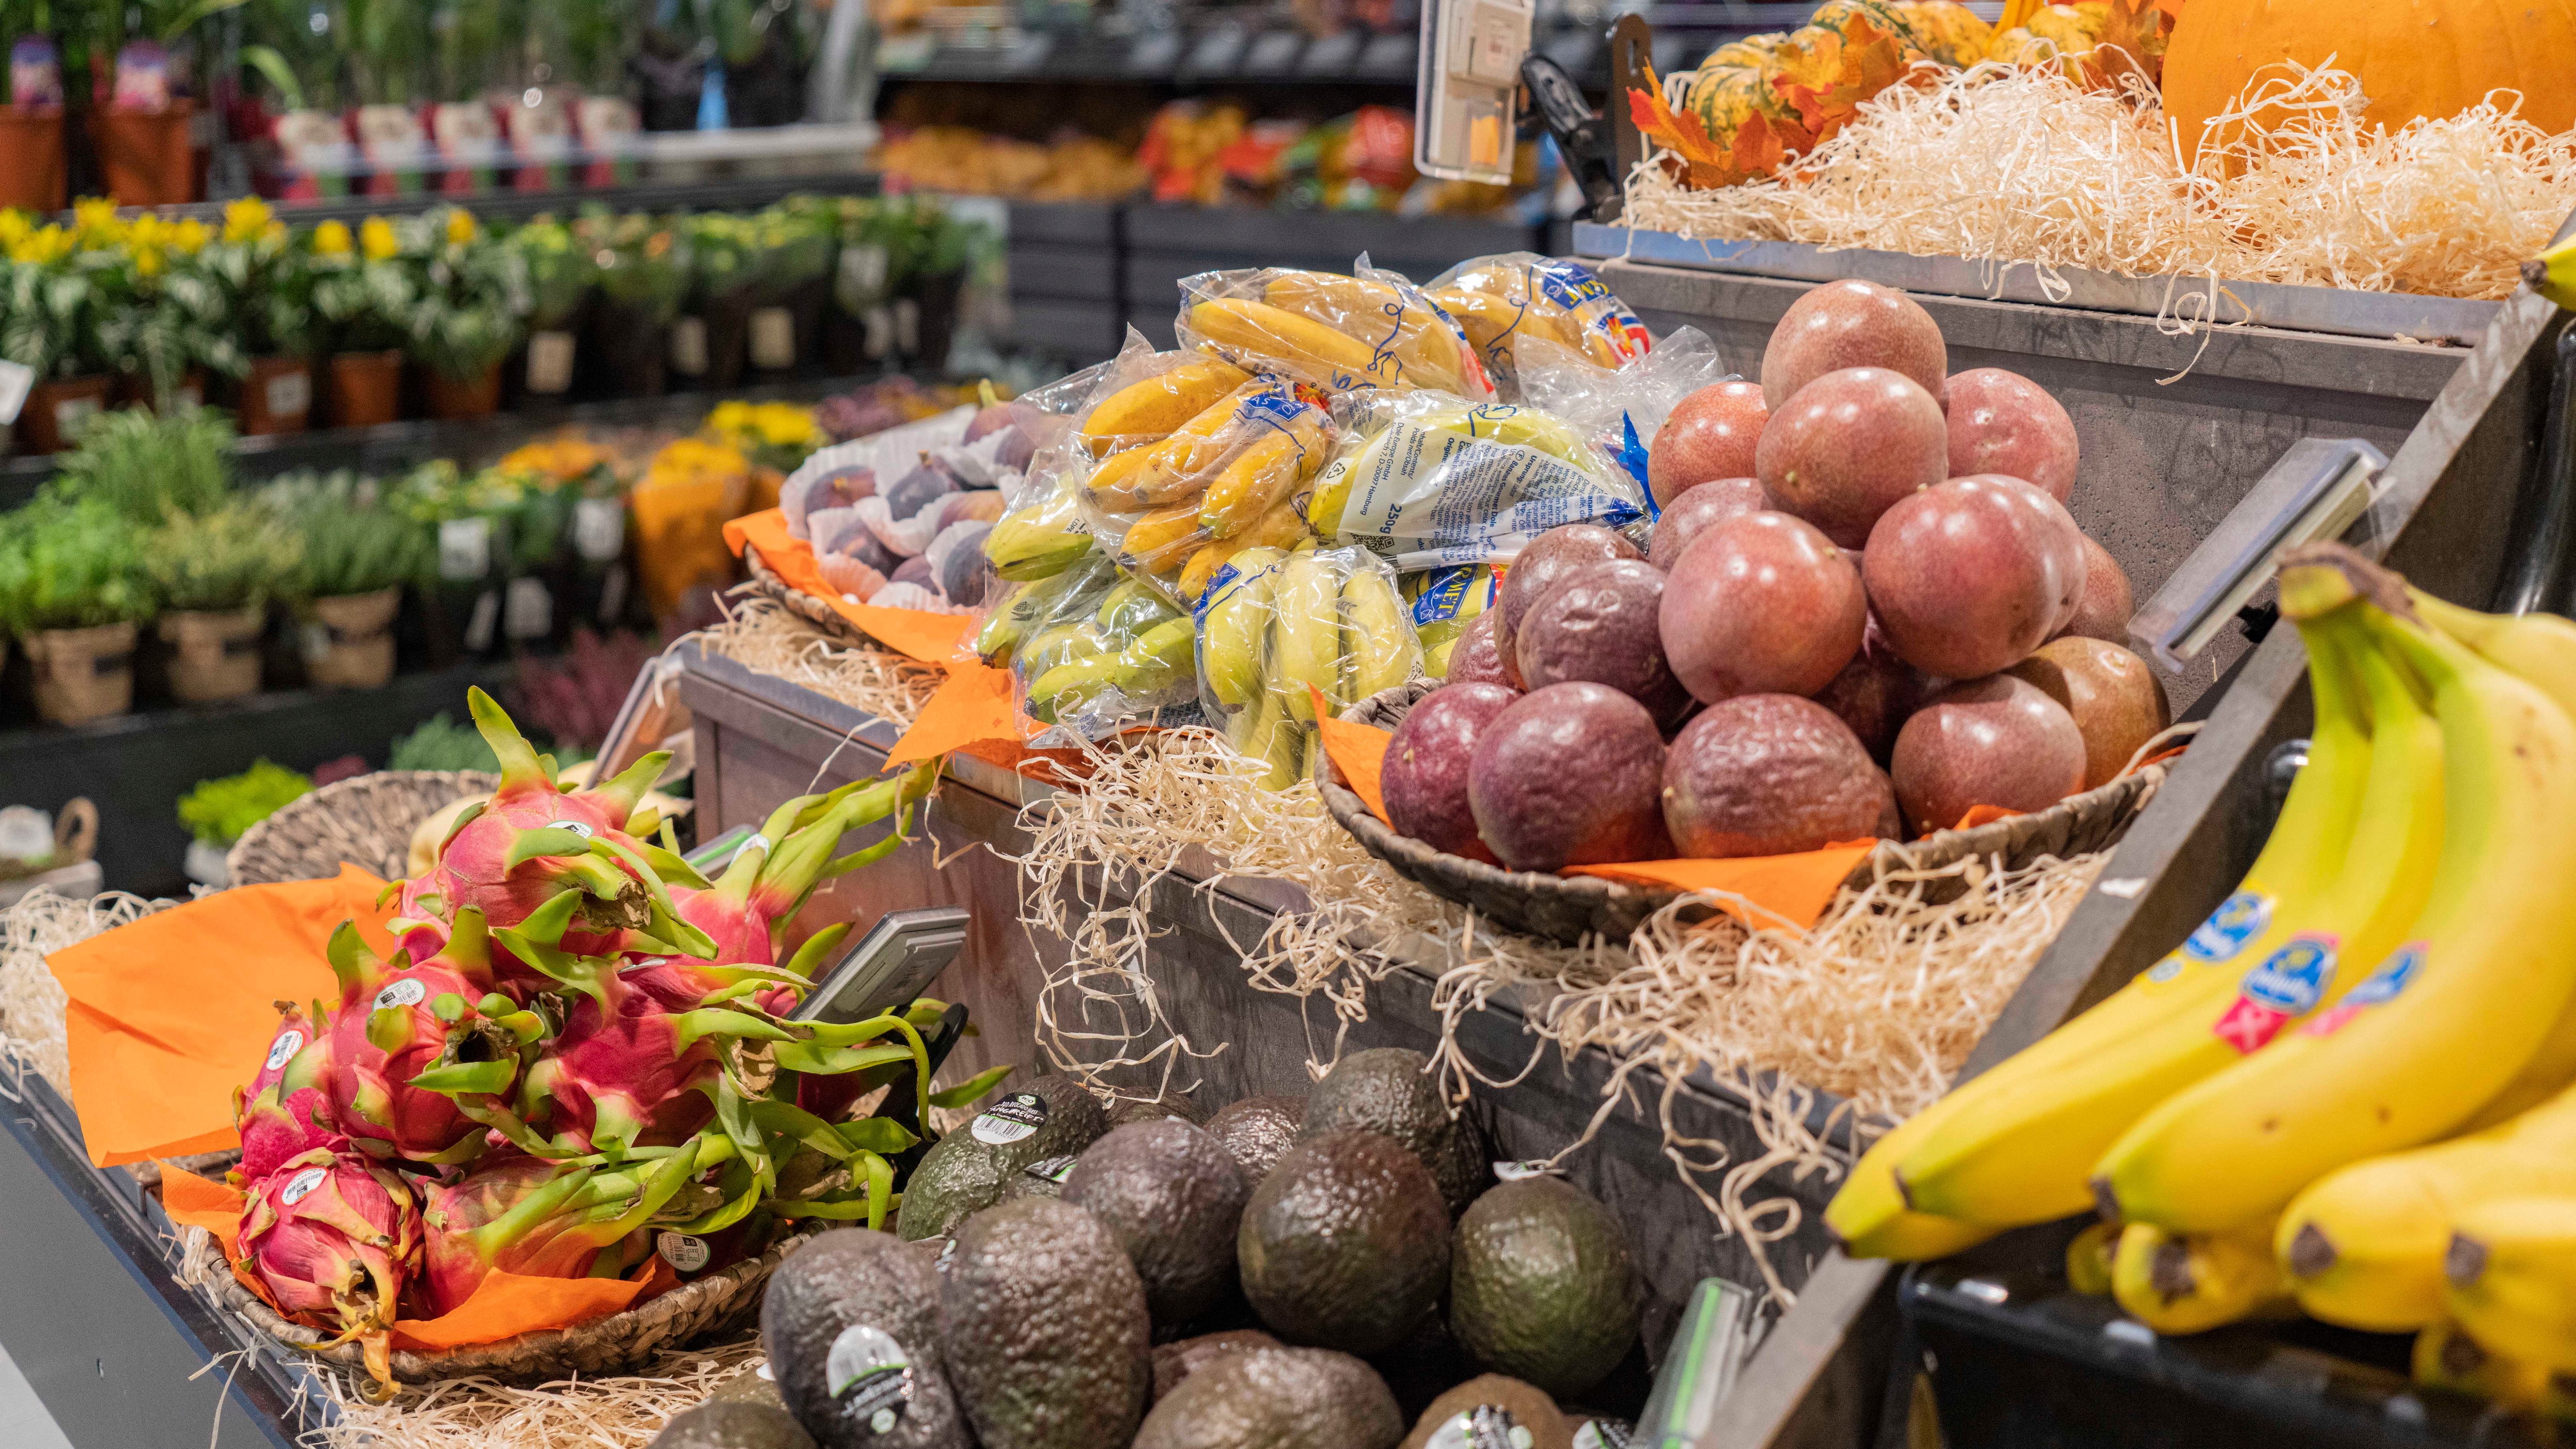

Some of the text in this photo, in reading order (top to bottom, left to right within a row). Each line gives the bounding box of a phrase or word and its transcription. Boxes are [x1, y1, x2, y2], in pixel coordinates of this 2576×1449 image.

[1381, 421, 1404, 481] Dole Europe GmbH
[1400, 427, 1420, 476] Poids net/Obsah
[1439, 436, 1455, 464] Origine:
[1452, 440, 1466, 465] Conseil:
[1462, 442, 1471, 456] pour
[1482, 445, 1491, 457] nous
[1490, 447, 1499, 458] Pour
[1371, 457, 1385, 485] D-20097
[1458, 459, 1466, 468] les
[1465, 461, 1479, 484] lorsque
[1478, 457, 1487, 473] vous
[1483, 458, 1495, 477] mieux
[1515, 454, 1537, 484] Ursprung:
[1449, 470, 1461, 494] amener
[1459, 466, 1470, 487] sachet
[1488, 469, 1502, 495] exotique
[1543, 463, 1557, 484] Früchte
[1551, 466, 1564, 484] schafft
[1560, 468, 1570, 484] wenn
[1440, 486, 1450, 498] fruit
[1454, 486, 1464, 498] crée
[1484, 483, 1493, 491] de
[1490, 481, 1506, 510] Gourmet
[1546, 485, 1555, 496] die
[1554, 484, 1563, 495] die
[1359, 485, 1376, 516] Hamburg
[1436, 497, 1444, 505] par
[1484, 493, 1492, 508] pour
[1379, 503, 1403, 536] 250g
[1429, 508, 1437, 522] bas.
[1436, 502, 1446, 526] maturité
[1442, 502, 1453, 534] conditions
[1458, 510, 1465, 520] de
[1489, 510, 1497, 528] Dole
[1065, 518, 1080, 533] LDPE
[1448, 510, 1459, 539] devenue
[1008, 1100, 1028, 1111] AVOCADO
